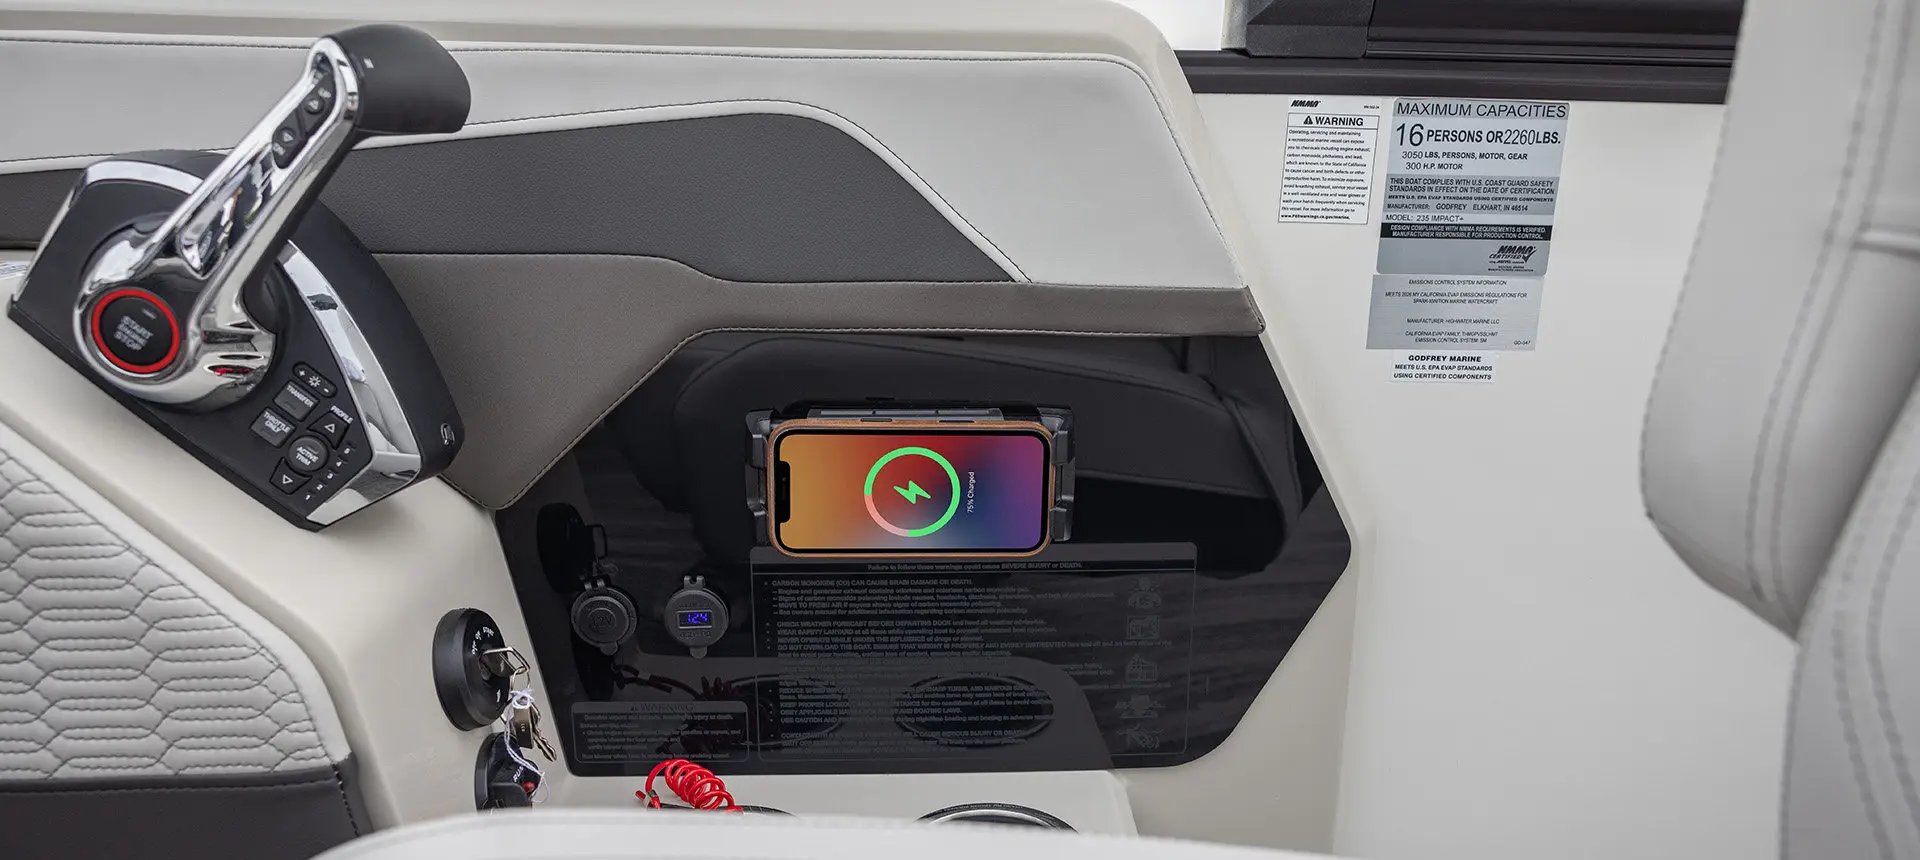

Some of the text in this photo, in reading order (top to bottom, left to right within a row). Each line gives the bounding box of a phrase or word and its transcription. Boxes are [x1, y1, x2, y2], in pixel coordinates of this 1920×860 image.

[1397, 103, 1567, 117] MAXIMUM CAPACITIES
[1315, 117, 1363, 126] WARNING
[1396, 123, 1561, 147] 16 PERSONS OR 2260 LBS.
[1402, 151, 1423, 159] 3050
[287, 384, 314, 407] TRANSFER
[264, 411, 291, 433] THROTTLE
[330, 405, 354, 425] PROFILE
[264, 420, 281, 433] ONLY
[296, 452, 311, 466] TRIM
[297, 446, 319, 462] ACTIVE
[967, 472, 976, 499] Charged
[483, 626, 494, 638] START
[640, 703, 695, 711] WARNING
